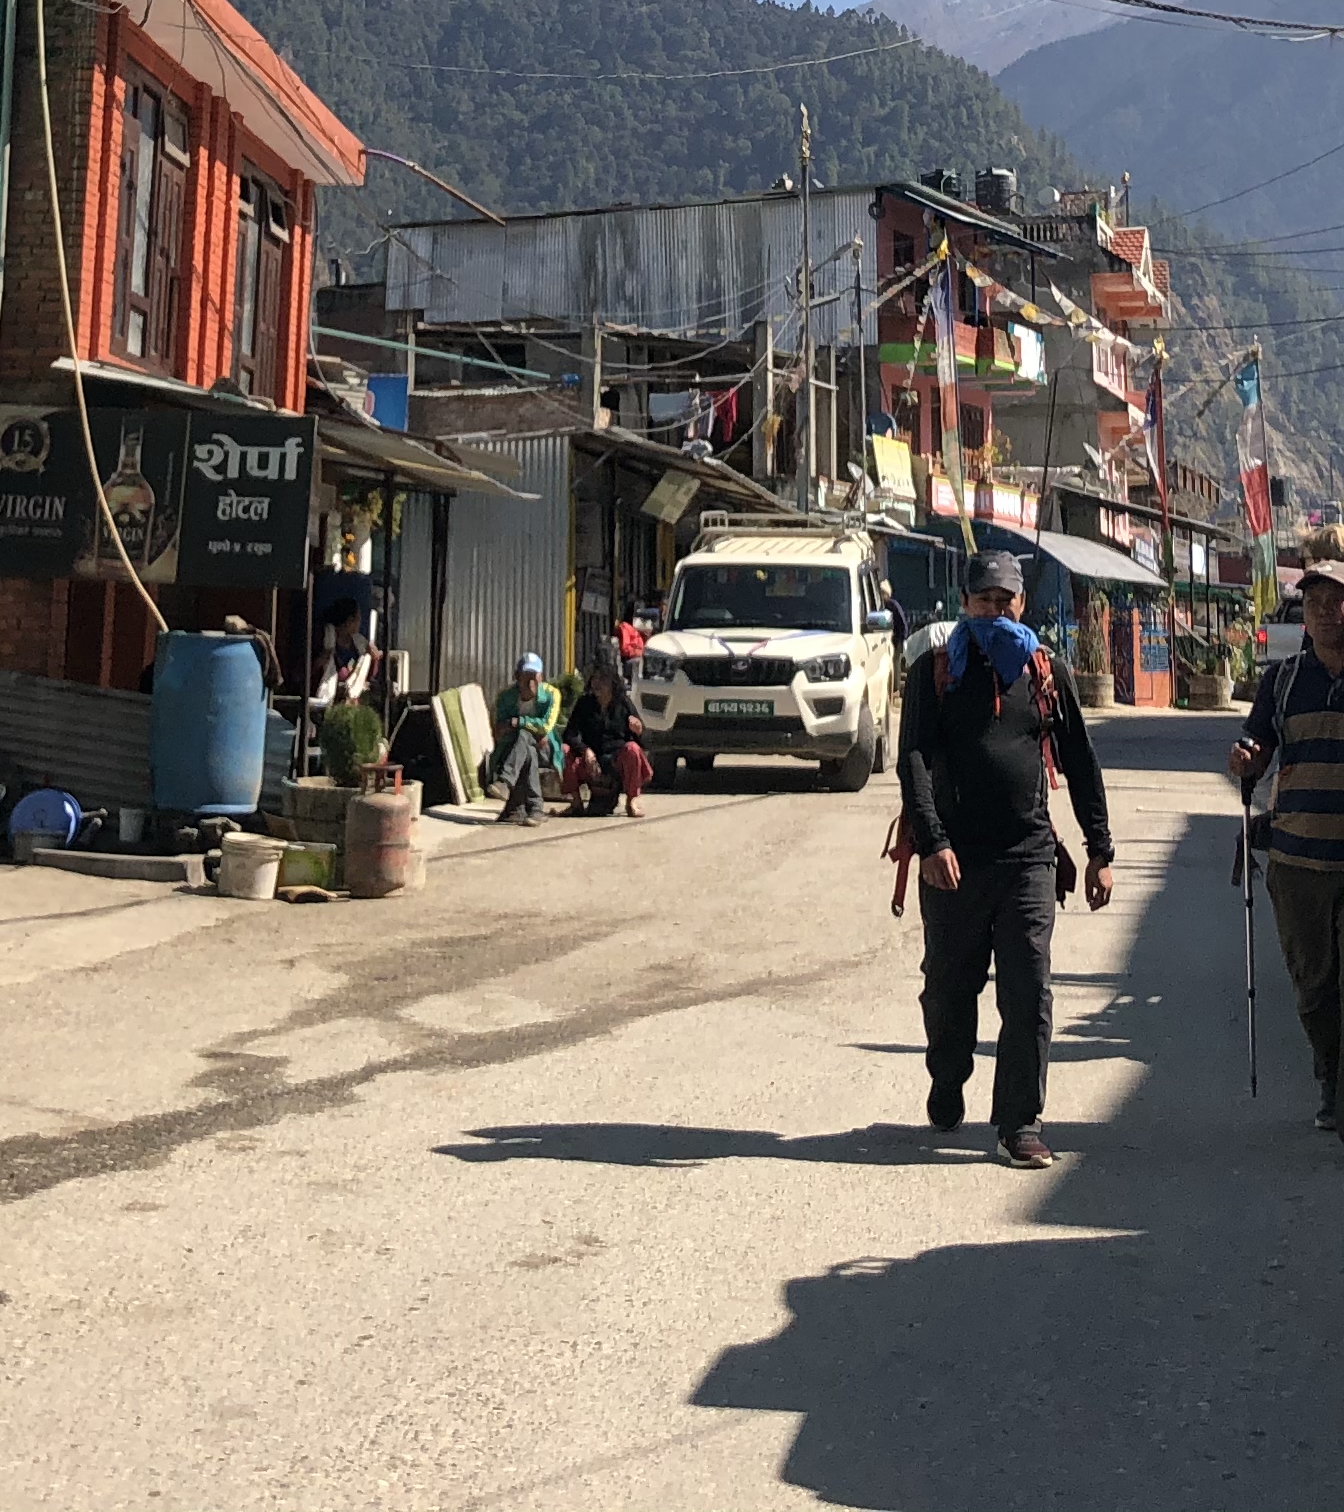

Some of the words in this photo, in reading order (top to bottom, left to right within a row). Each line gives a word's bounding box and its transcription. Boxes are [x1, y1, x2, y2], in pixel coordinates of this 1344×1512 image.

[11, 428, 34, 452] 15
[193, 433, 304, 480] शेर्पा
[216, 489, 271, 521] होटल
